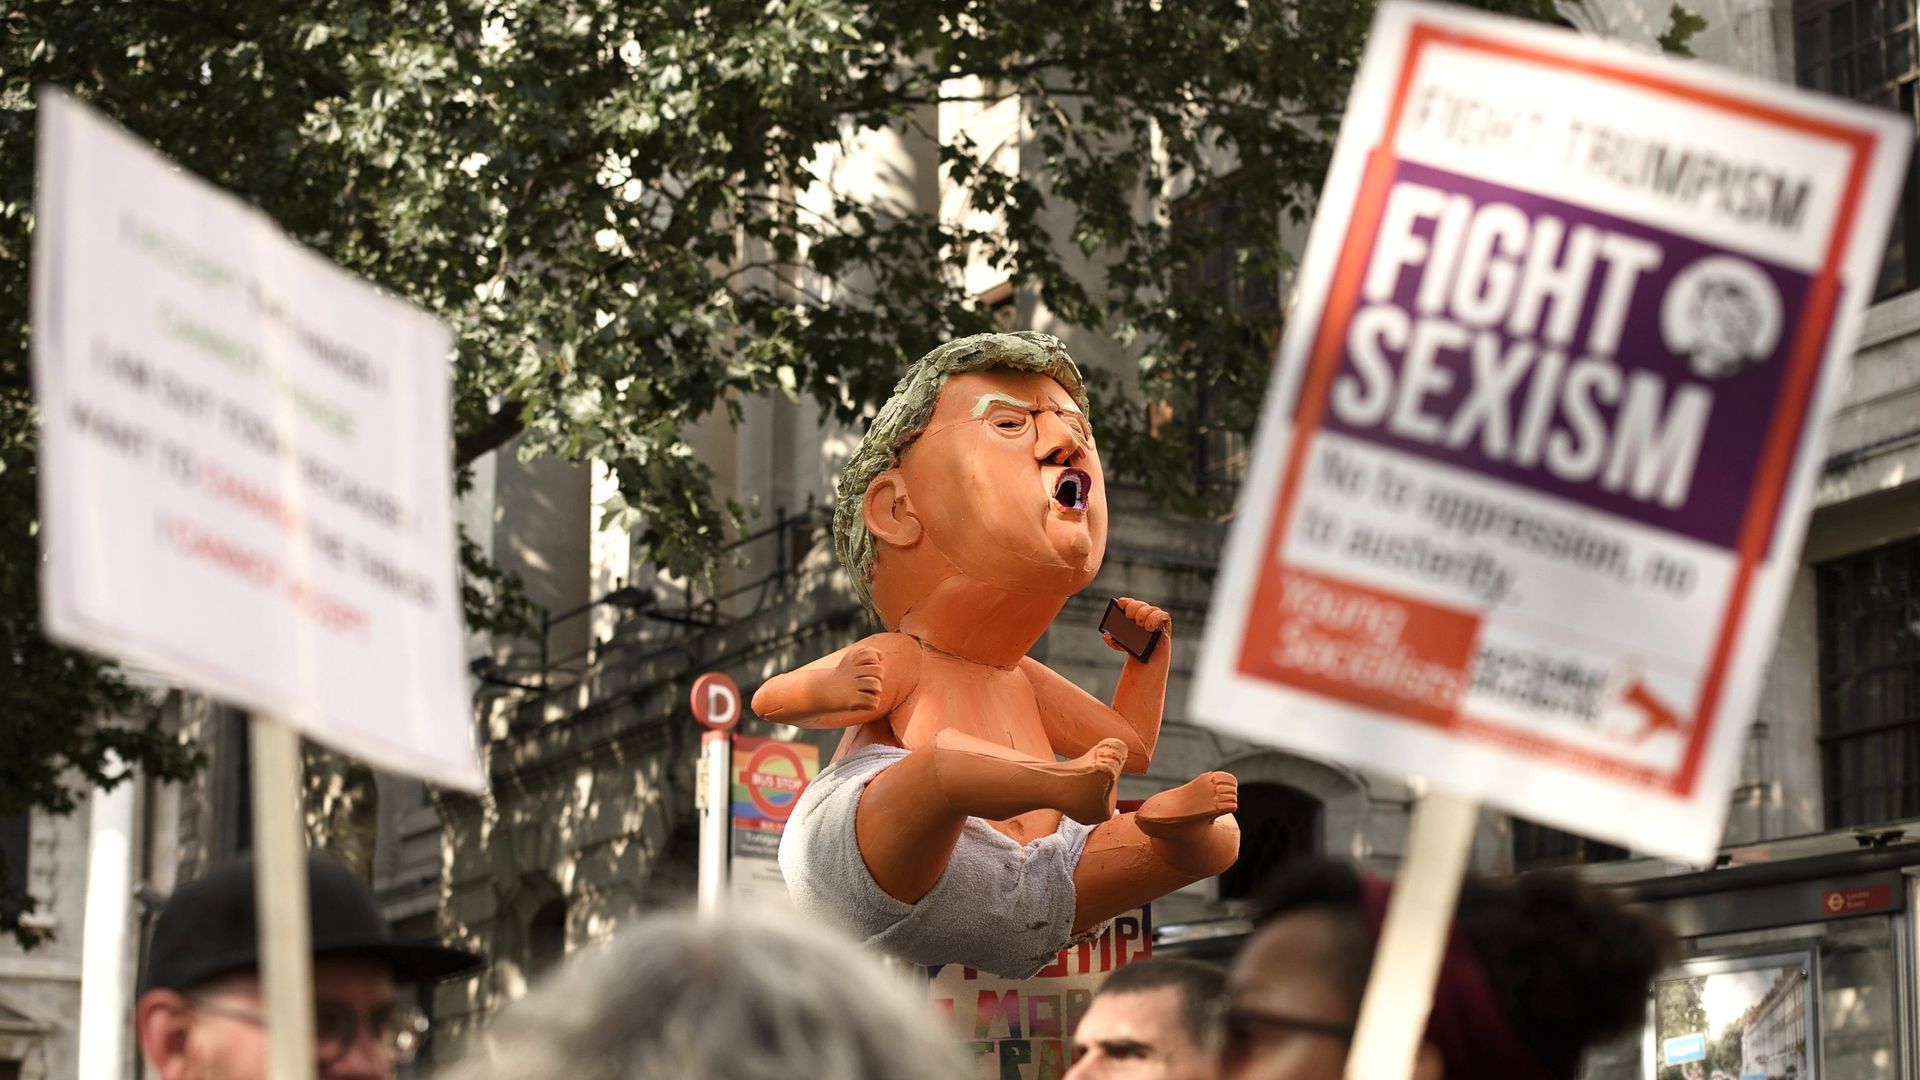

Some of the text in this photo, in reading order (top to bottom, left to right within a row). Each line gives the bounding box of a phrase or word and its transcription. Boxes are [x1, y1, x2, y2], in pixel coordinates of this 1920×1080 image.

[1411, 86, 1814, 232] FIGHT TRUMPISM
[1365, 180, 1664, 357] FIGHT
[1332, 304, 1714, 508] SEXISM
[1301, 507, 1341, 557] to
[1319, 447, 1697, 596] No to oppression, no
[1279, 575, 1408, 646] Young
[708, 684, 736, 723] D
[1273, 617, 1463, 711] Socialists
[752, 773, 803, 792] BUS STOP
